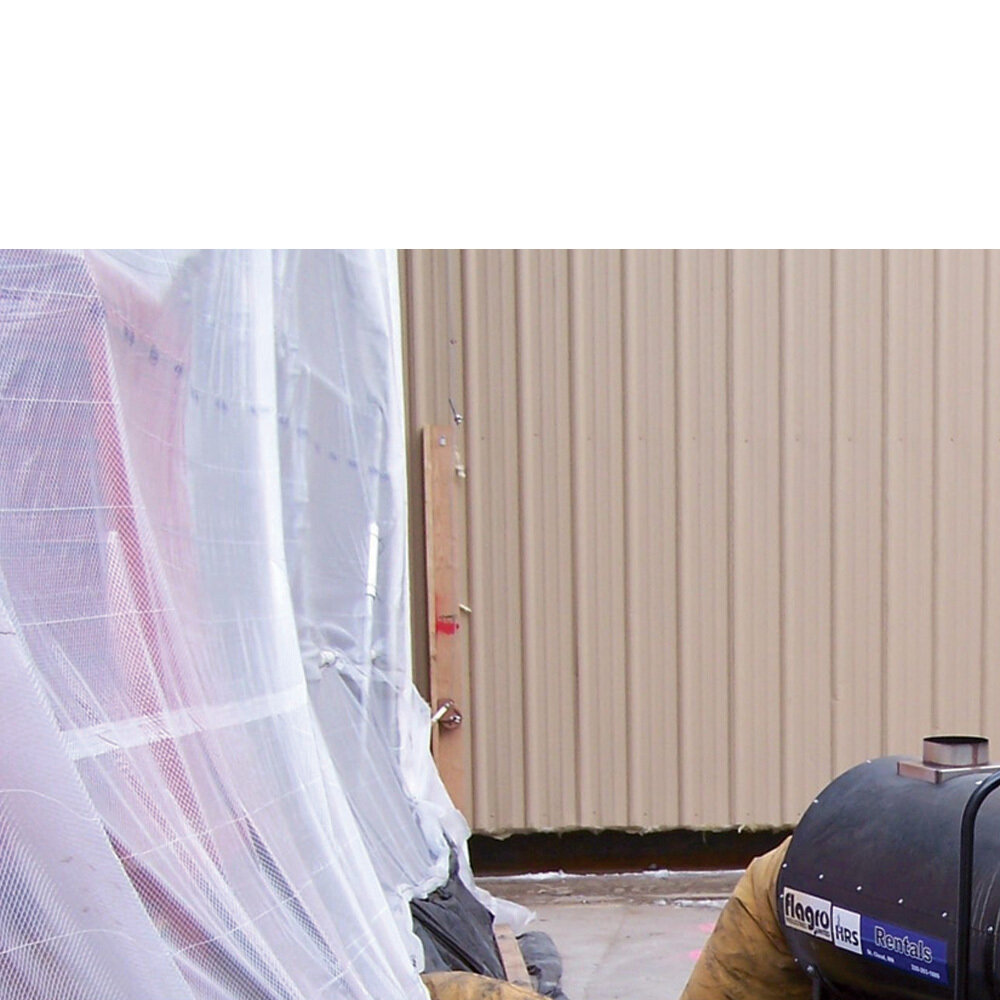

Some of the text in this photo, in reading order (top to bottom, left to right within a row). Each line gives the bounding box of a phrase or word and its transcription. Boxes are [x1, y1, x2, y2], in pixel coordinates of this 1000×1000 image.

[785, 893, 829, 930] flagro
[835, 924, 859, 946] HRS
[874, 926, 933, 964] Rentals
